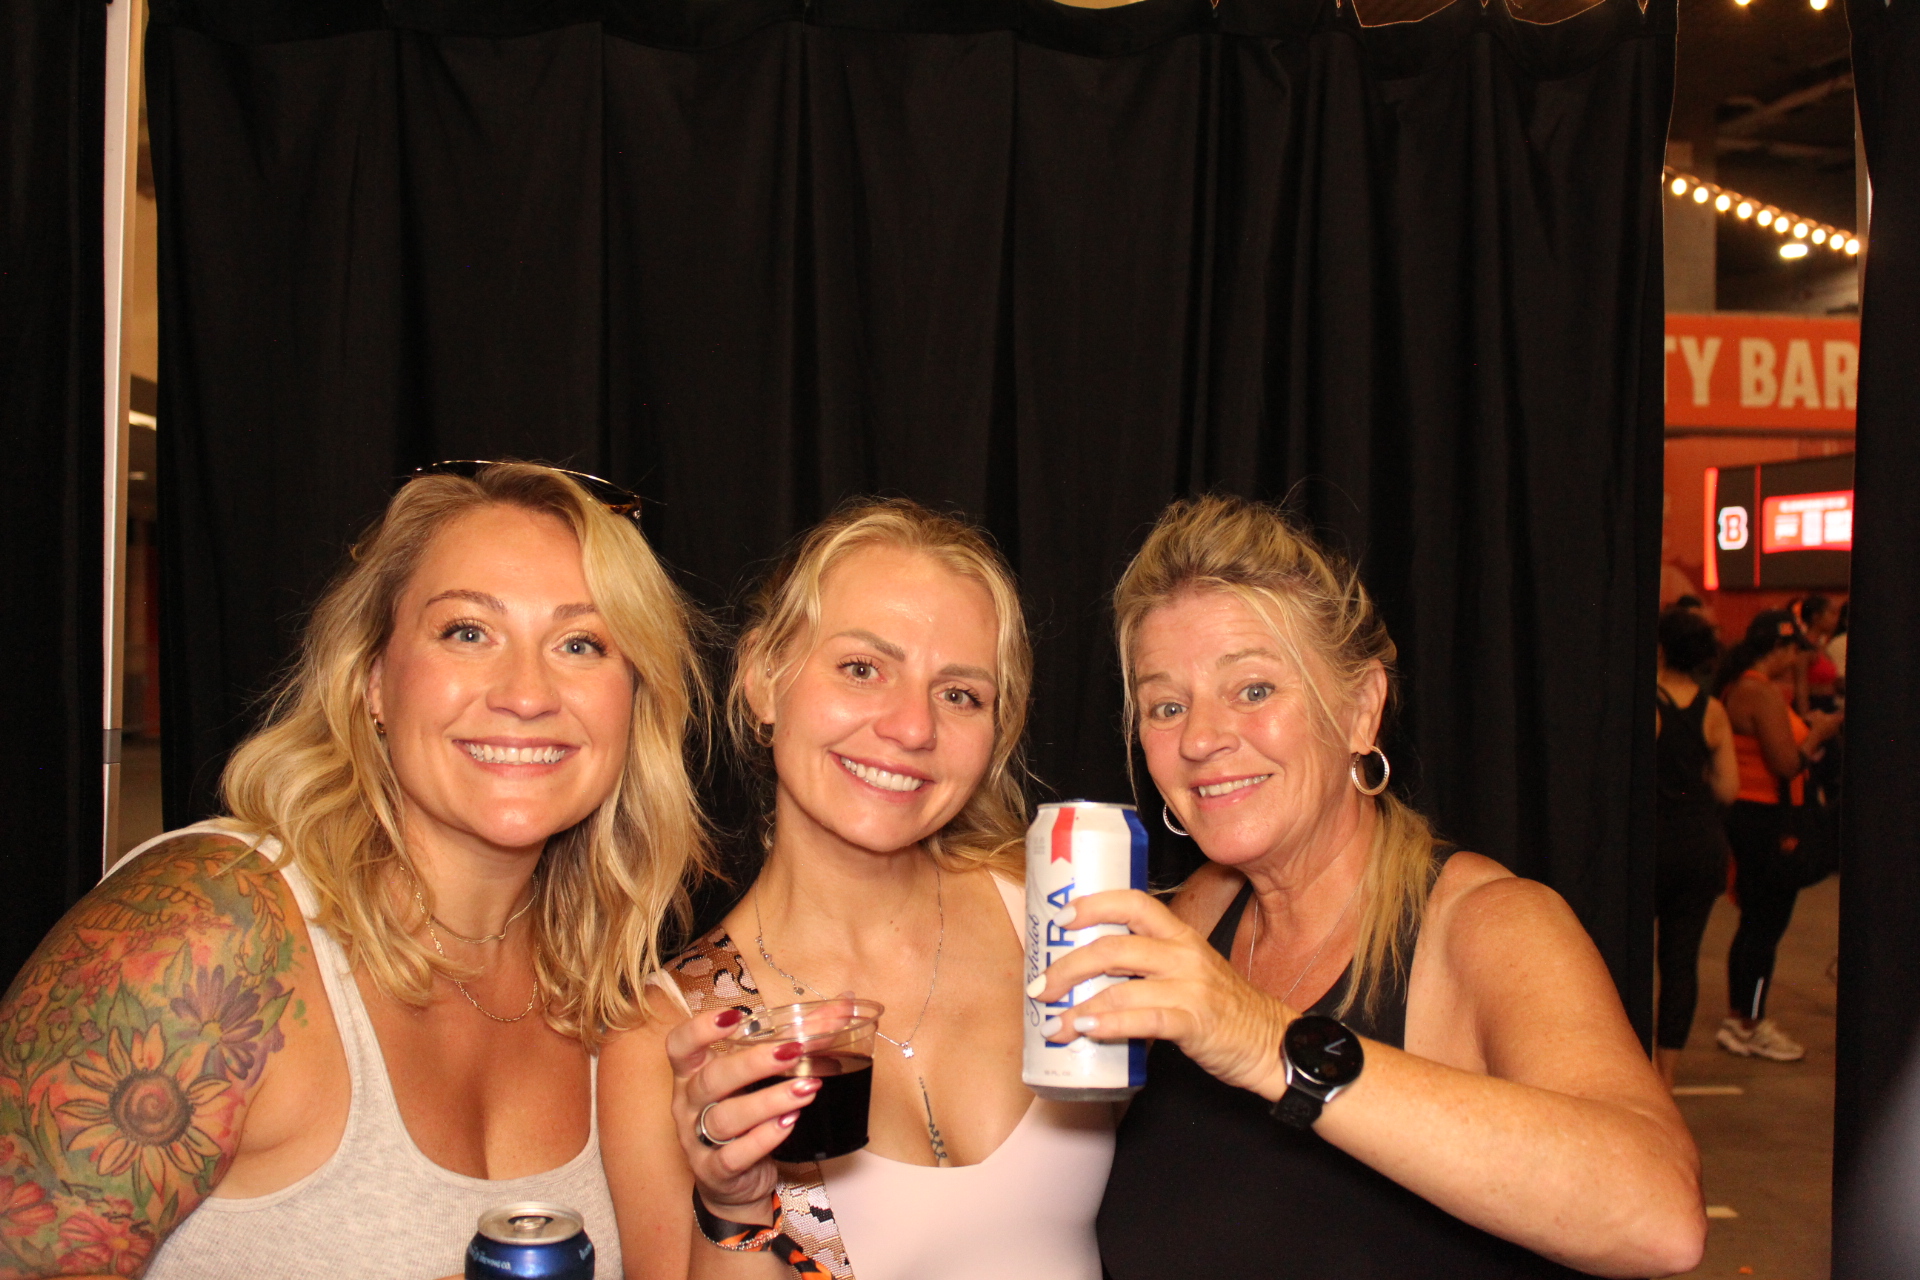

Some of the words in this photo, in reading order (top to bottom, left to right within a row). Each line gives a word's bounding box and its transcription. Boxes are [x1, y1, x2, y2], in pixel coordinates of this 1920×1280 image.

[1740, 337, 1859, 410] BAR
[1026, 914, 1040, 1027] chelob
[1045, 882, 1075, 1048] LRA
